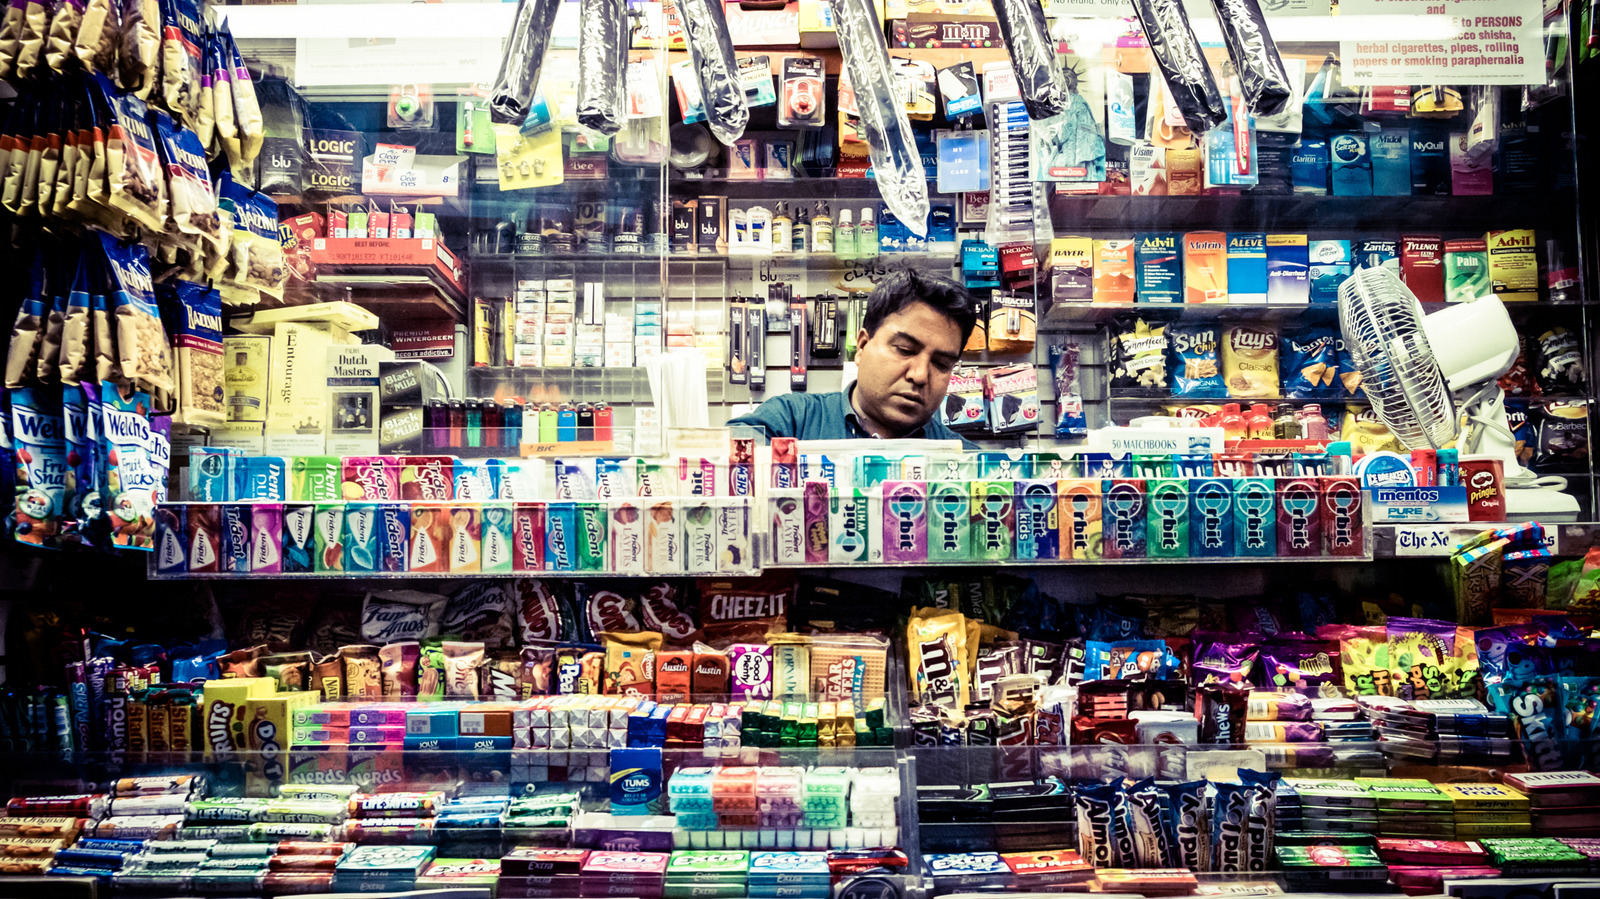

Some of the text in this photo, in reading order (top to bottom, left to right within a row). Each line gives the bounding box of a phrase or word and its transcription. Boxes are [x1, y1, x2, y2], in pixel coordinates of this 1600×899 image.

[1427, 4, 1446, 15] and
[1462, 16, 1523, 28] to PERSONS
[1479, 29, 1516, 41] shisha,
[1356, 41, 1519, 55] herbal cigarettes, pipes, rolling
[1353, 54, 1524, 68] papers or smoking paraphernalia
[1377, 135, 1402, 144] Midol
[310, 139, 353, 154] LOGIC
[1133, 147, 1154, 157] Visine
[1413, 141, 1444, 151] NyQuil
[271, 154, 291, 169] blu
[1292, 155, 1316, 163] Claritin
[312, 175, 351, 187] LOGIC
[675, 218, 689, 230] blu
[701, 224, 717, 235] blu
[1142, 237, 1175, 248] Advil
[1190, 241, 1222, 250] Motrin
[1229, 237, 1264, 247] ALEVE
[1363, 241, 1396, 252] Zantac
[1405, 241, 1439, 251] TYLENOL
[1496, 236, 1530, 247] Advil
[1002, 245, 1033, 255] TROJAN
[1054, 249, 1084, 257] BAYER
[1456, 255, 1479, 267] Pain
[759, 270, 777, 282] blu
[993, 295, 1034, 306] DURACELL
[395, 335, 454, 343] WINTERGREEN
[1175, 330, 1214, 352] Sun
[339, 354, 368, 366] Dutch
[281, 334, 297, 404] Entourage
[334, 365, 372, 377] Masters
[1238, 362, 1273, 373] Classic
[385, 370, 415, 384] Black
[394, 378, 418, 395] Mild
[107, 412, 149, 440] Welch's
[384, 412, 419, 429] Black
[394, 423, 421, 441] Mild
[1112, 440, 1177, 449] 50 MATCHBOOKS
[1378, 470, 1411, 484] BREAKERS
[1378, 488, 1439, 502] mentos
[1470, 486, 1497, 505] Pringles
[857, 498, 866, 532] WHITE
[225, 505, 246, 559] Trident
[297, 509, 306, 543] Trident
[328, 509, 336, 543] Trident
[359, 509, 367, 543] Trident
[385, 504, 402, 558] Trident
[583, 505, 601, 557] Trident
[1018, 513, 1029, 541] kids
[523, 515, 537, 569] Trident
[554, 515, 568, 570] Trident
[1400, 530, 1427, 549] The
[417, 532, 426, 565] Trident
[489, 531, 497, 564] Trident
[711, 592, 787, 620] CHEEZ-IT
[661, 662, 689, 673] Austin
[695, 664, 722, 675] Austin
[740, 654, 752, 684] Plenty
[753, 655, 763, 681] Good
[419, 740, 438, 749] JOLLY
[474, 740, 494, 749] JOLLY
[624, 778, 649, 788] TUMS
[1373, 786, 1438, 794] DOUBLEMINT
[363, 799, 420, 809] LIFE SAVERS
[199, 808, 248, 820] LIFE SAVERS
[528, 861, 554, 870] Extra
[672, 853, 745, 867] Extra
[754, 853, 818, 867] Extra
[933, 854, 999, 870] Extra
[777, 873, 803, 883] Extra
[692, 887, 718, 896] Extra
[776, 887, 802, 897] Extra
